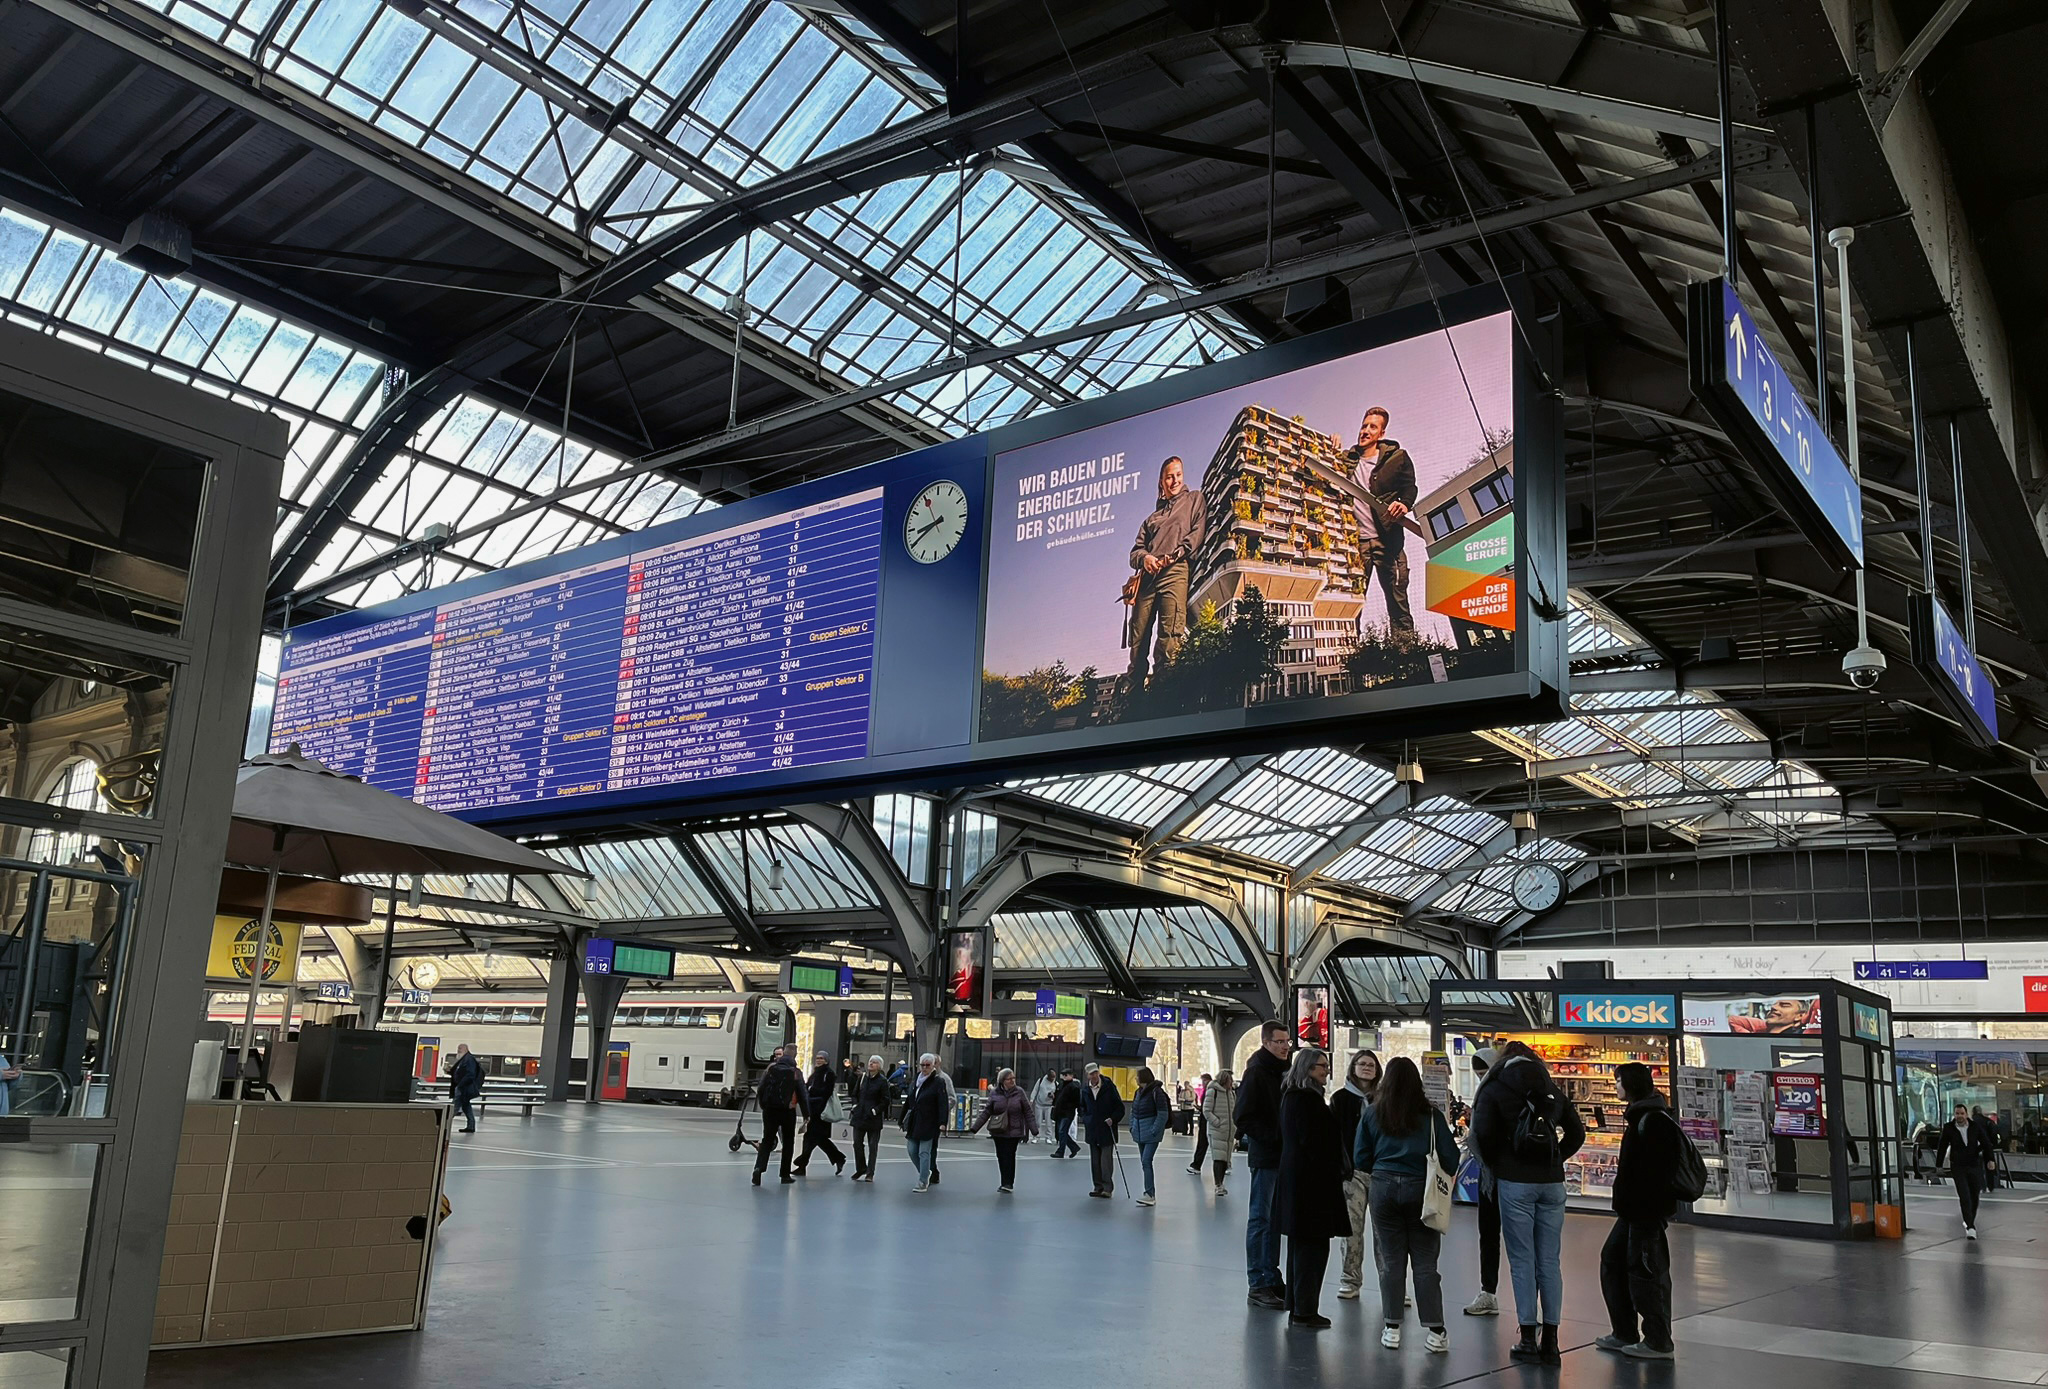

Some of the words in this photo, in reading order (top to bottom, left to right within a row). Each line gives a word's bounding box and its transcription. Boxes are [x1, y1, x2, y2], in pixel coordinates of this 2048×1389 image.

[1763, 380, 1772, 422] 3
[1797, 430, 1810, 475] 10
[1019, 474, 1046, 496] WIR
[1050, 460, 1096, 488] BAUEN
[1101, 452, 1126, 475] DIE
[1018, 472, 1141, 519] ENERGIEZUKUNFT
[1016, 520, 1043, 542] DER
[1047, 502, 1115, 535] SCHWEIZ.
[662, 546, 703, 563] Schaffhausen
[713, 537, 736, 549] Oerlikon
[740, 530, 760, 542] Bülach
[794, 520, 800, 528] 5
[1046, 527, 1115, 550] gebäudehülle.swiss
[1464, 536, 1508, 552] GROSSE
[660, 562, 683, 576] Lugano
[693, 557, 704, 568] Zug
[707, 551, 726, 562] Altdorf
[729, 542, 758, 556] Bellinzona
[793, 532, 798, 540] 6
[705, 563, 722, 575] Brugg
[725, 558, 742, 569] Aarau
[789, 544, 798, 553] 13
[1466, 546, 1508, 562] BERUFE
[657, 590, 699, 607] Schaffhausen
[710, 580, 742, 594] Hardbrücke
[745, 573, 770, 586] Oerlikon
[787, 564, 807, 576] 41/42
[687, 580, 696, 589] SZ
[735, 567, 750, 579] Enge
[788, 555, 796, 564] 31
[657, 608, 673, 618] Basel
[675, 604, 688, 613] SBB
[698, 595, 724, 609] Lenzburg
[727, 591, 744, 601] Aarau
[747, 585, 767, 596] Liestal
[786, 578, 795, 588] 16
[1462, 593, 1508, 608] ENERGIE
[1486, 582, 1508, 595] DER
[654, 631, 666, 641] Zug
[677, 621, 709, 634] Hardbrücke
[711, 614, 738, 627] Altstetten
[741, 610, 760, 620] Urdorf
[784, 600, 804, 612] 41/42
[665, 616, 685, 626] Gallen
[695, 608, 718, 619] Oerlikon
[721, 603, 739, 613] Zürich
[751, 593, 782, 607] Winterthur
[786, 590, 794, 599] 12
[1468, 602, 1508, 618] WENDE
[652, 651, 669, 661] Basel
[670, 648, 684, 657] SBB
[694, 640, 721, 652] Altstetten
[724, 635, 747, 646] Dietikon
[782, 626, 791, 635] 32
[653, 637, 687, 652] Rapperswil
[688, 634, 698, 642] SG
[709, 624, 742, 638] Stadelhofen
[746, 620, 762, 630] Uster
[783, 611, 803, 623] 43/44
[651, 662, 672, 672] Luzern
[682, 657, 694, 668] Zug
[785, 638, 790, 646] 9
[809, 628, 837, 643] Gruppen
[838, 623, 860, 635] Sektor
[861, 622, 867, 630] C
[1950, 641, 1956, 675] 11
[649, 682, 683, 696] Rapperswil
[684, 680, 694, 688] SG
[704, 671, 739, 684] Stadelhofen
[742, 667, 762, 677] Meilen
[779, 660, 800, 671] 43/44
[650, 672, 675, 683] Dietikon
[686, 665, 712, 676] Altstetten
[780, 650, 789, 659] 31
[647, 709, 662, 718] Chur
[727, 692, 758, 706] Landquart
[781, 687, 786, 695] 8
[805, 679, 833, 693] Gruppen
[834, 675, 856, 686] Sektor
[858, 674, 863, 682] B
[648, 696, 667, 705] Hinwil
[677, 690, 700, 700] Oerlikon
[736, 677, 768, 690] Dübendorf
[778, 674, 787, 683] 33
[722, 717, 740, 726] Zürich
[779, 710, 784, 718] 3
[642, 752, 661, 762] Brugg
[682, 744, 715, 755] Hardbrücke
[718, 740, 746, 750] Altstetten
[773, 733, 794, 743] 41/42
[643, 740, 663, 750] Zürich
[664, 736, 695, 748] Flughafen
[715, 729, 739, 739] Oerlikon
[774, 722, 783, 731] 34
[719, 750, 755, 762] Stadelhofen
[772, 745, 793, 756] 43/44
[640, 775, 660, 784] Zürich
[661, 771, 692, 783] Flughafen
[712, 765, 736, 775] Oerlikon
[771, 758, 792, 768] 41/42
[234, 944, 282, 958] FEDRAL
[586, 962, 594, 971] 12
[598, 962, 608, 972] 12
[1880, 968, 1892, 977] 41
[1912, 968, 1927, 977] 44
[322, 986, 332, 996] 12
[338, 988, 346, 996] A
[420, 994, 429, 1002] 13
[842, 987, 848, 996] 13
[2032, 982, 2048, 992] die
[1586, 999, 1670, 1024] kiosk
[1786, 1092, 1812, 1104] 120
